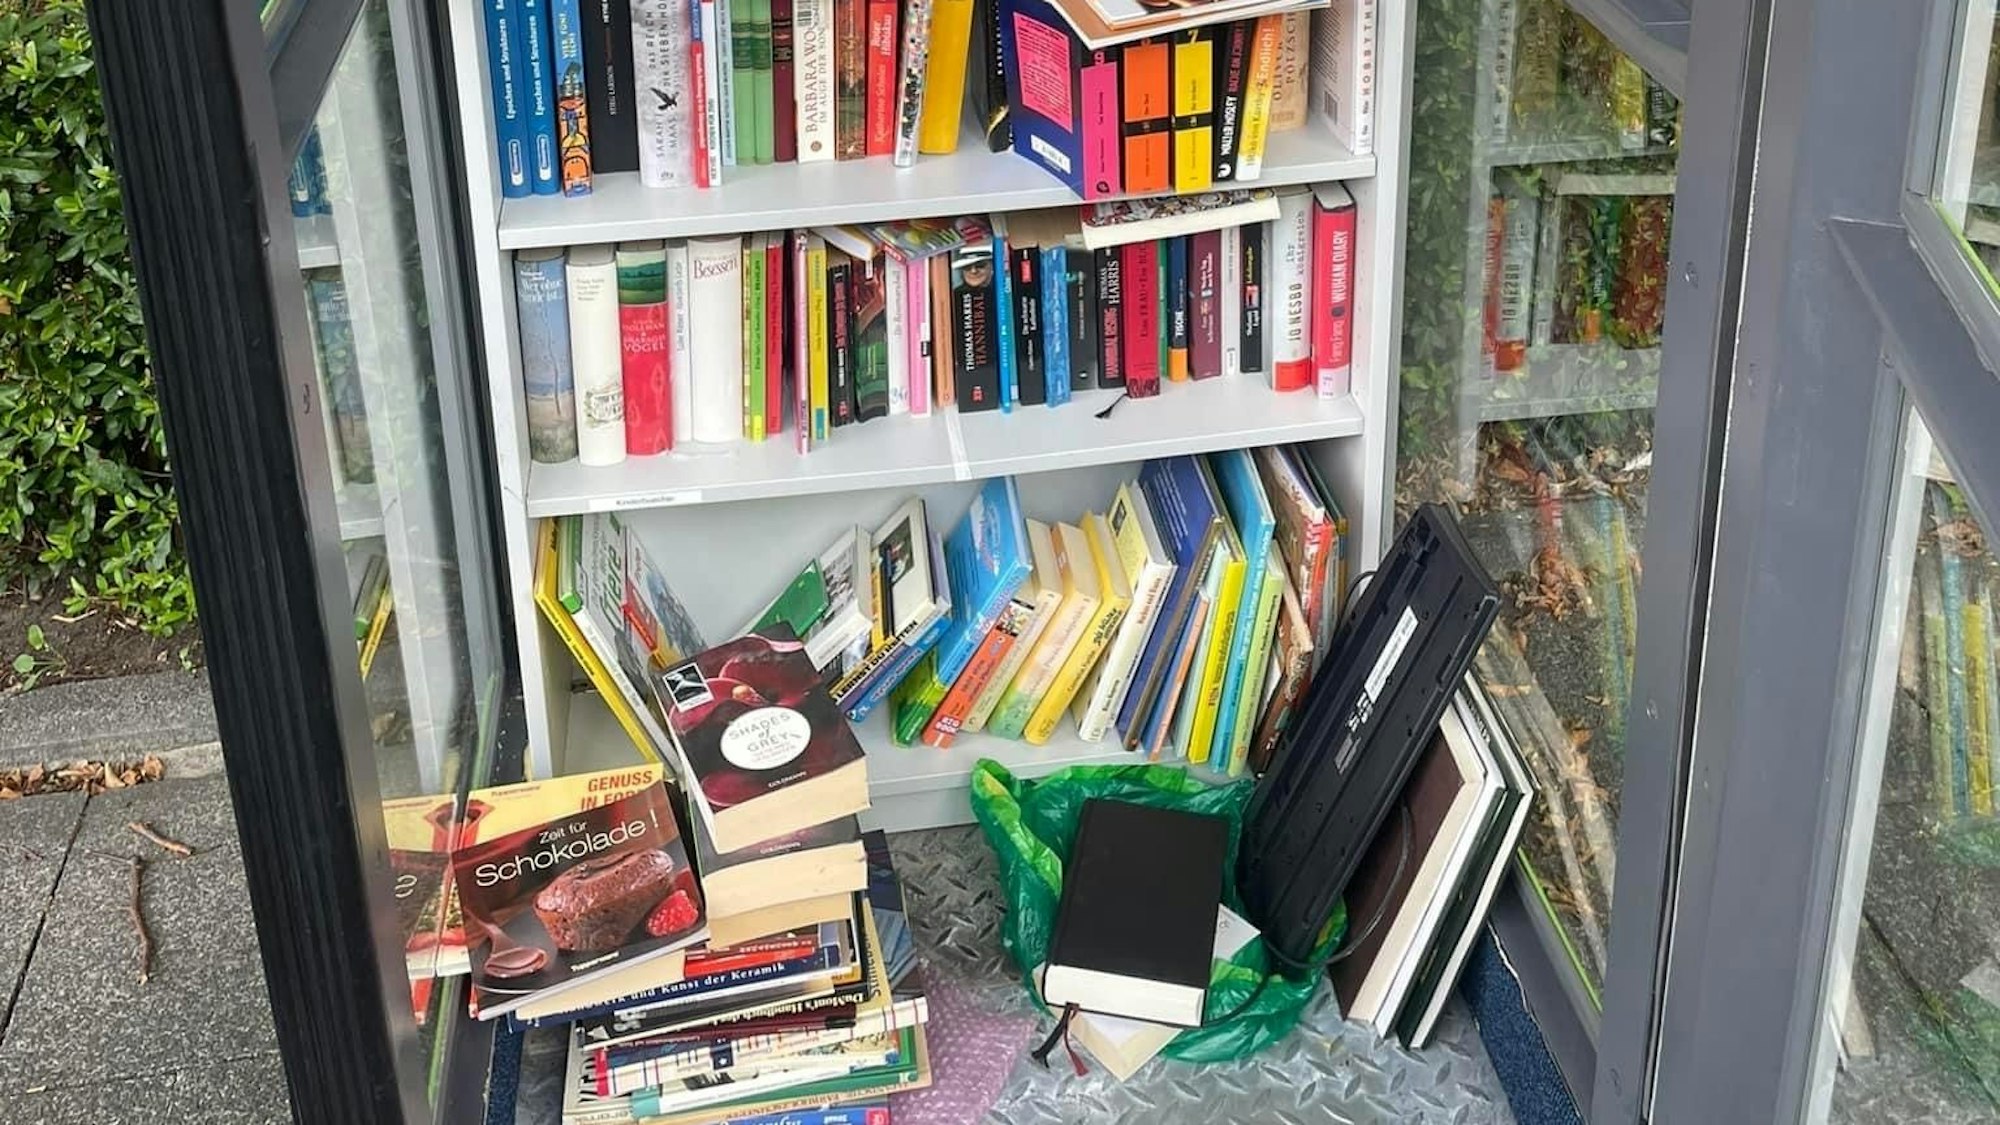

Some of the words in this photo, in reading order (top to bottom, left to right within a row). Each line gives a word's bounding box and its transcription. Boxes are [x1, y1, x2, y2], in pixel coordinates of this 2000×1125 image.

[498, 18, 510, 63] Strukturen
[528, 15, 540, 60] Strukturen
[645, 11, 655, 47] REICH
[659, 23, 670, 66] SIEBEN
[1255, 27, 1274, 79] Endlich!
[502, 65, 511, 81] und
[530, 61, 541, 78] und
[648, 51, 657, 69] DAS
[818, 54, 827, 74] DER
[606, 65, 616, 95] LARSSON
[663, 70, 672, 87] DER
[818, 80, 827, 106] AUGE
[503, 82, 516, 119] Epochen
[531, 80, 545, 116] Epochen
[609, 95, 617, 115] STIEG
[804, 59, 819, 133] BARBARA
[1223, 95, 1239, 126] MOSLEY
[819, 111, 828, 123] IM
[875, 96, 889, 144] Katherine
[656, 121, 665, 158] SARAH
[669, 117, 677, 148] MAAS
[1220, 126, 1235, 156] WALTER
[1332, 230, 1348, 261] DIARY
[1099, 267, 1108, 300] THOMAS
[1107, 260, 1120, 304] HARRIS
[1330, 262, 1347, 303] WUHAN
[962, 293, 973, 329] HARRIS
[1103, 307, 1118, 336] RISING
[1175, 310, 1184, 337] FISCHE
[972, 292, 988, 366] HANNIBAL
[1287, 328, 1302, 341] JO
[624, 342, 665, 353] VOGEL
[964, 331, 975, 371] THOMAS
[1104, 336, 1120, 379] HANNIBAL
[599, 545, 622, 630] Tiere
[728, 712, 791, 740] SHADES
[758, 726, 771, 739] of
[747, 732, 789, 752] GREY
[588, 770, 653, 793] GENUSS
[768, 771, 807, 788] GOLDMANN
[581, 795, 595, 811] IN
[539, 824, 566, 845] Zeit
[569, 819, 588, 835] für
[475, 818, 647, 887] Schokolade
[629, 987, 655, 999] und
[660, 978, 698, 993] Kunst
[703, 973, 724, 986] der
[729, 961, 785, 981] Keramik
[742, 1001, 803, 1021] Handbuch
[804, 991, 864, 1011] DuMont's
